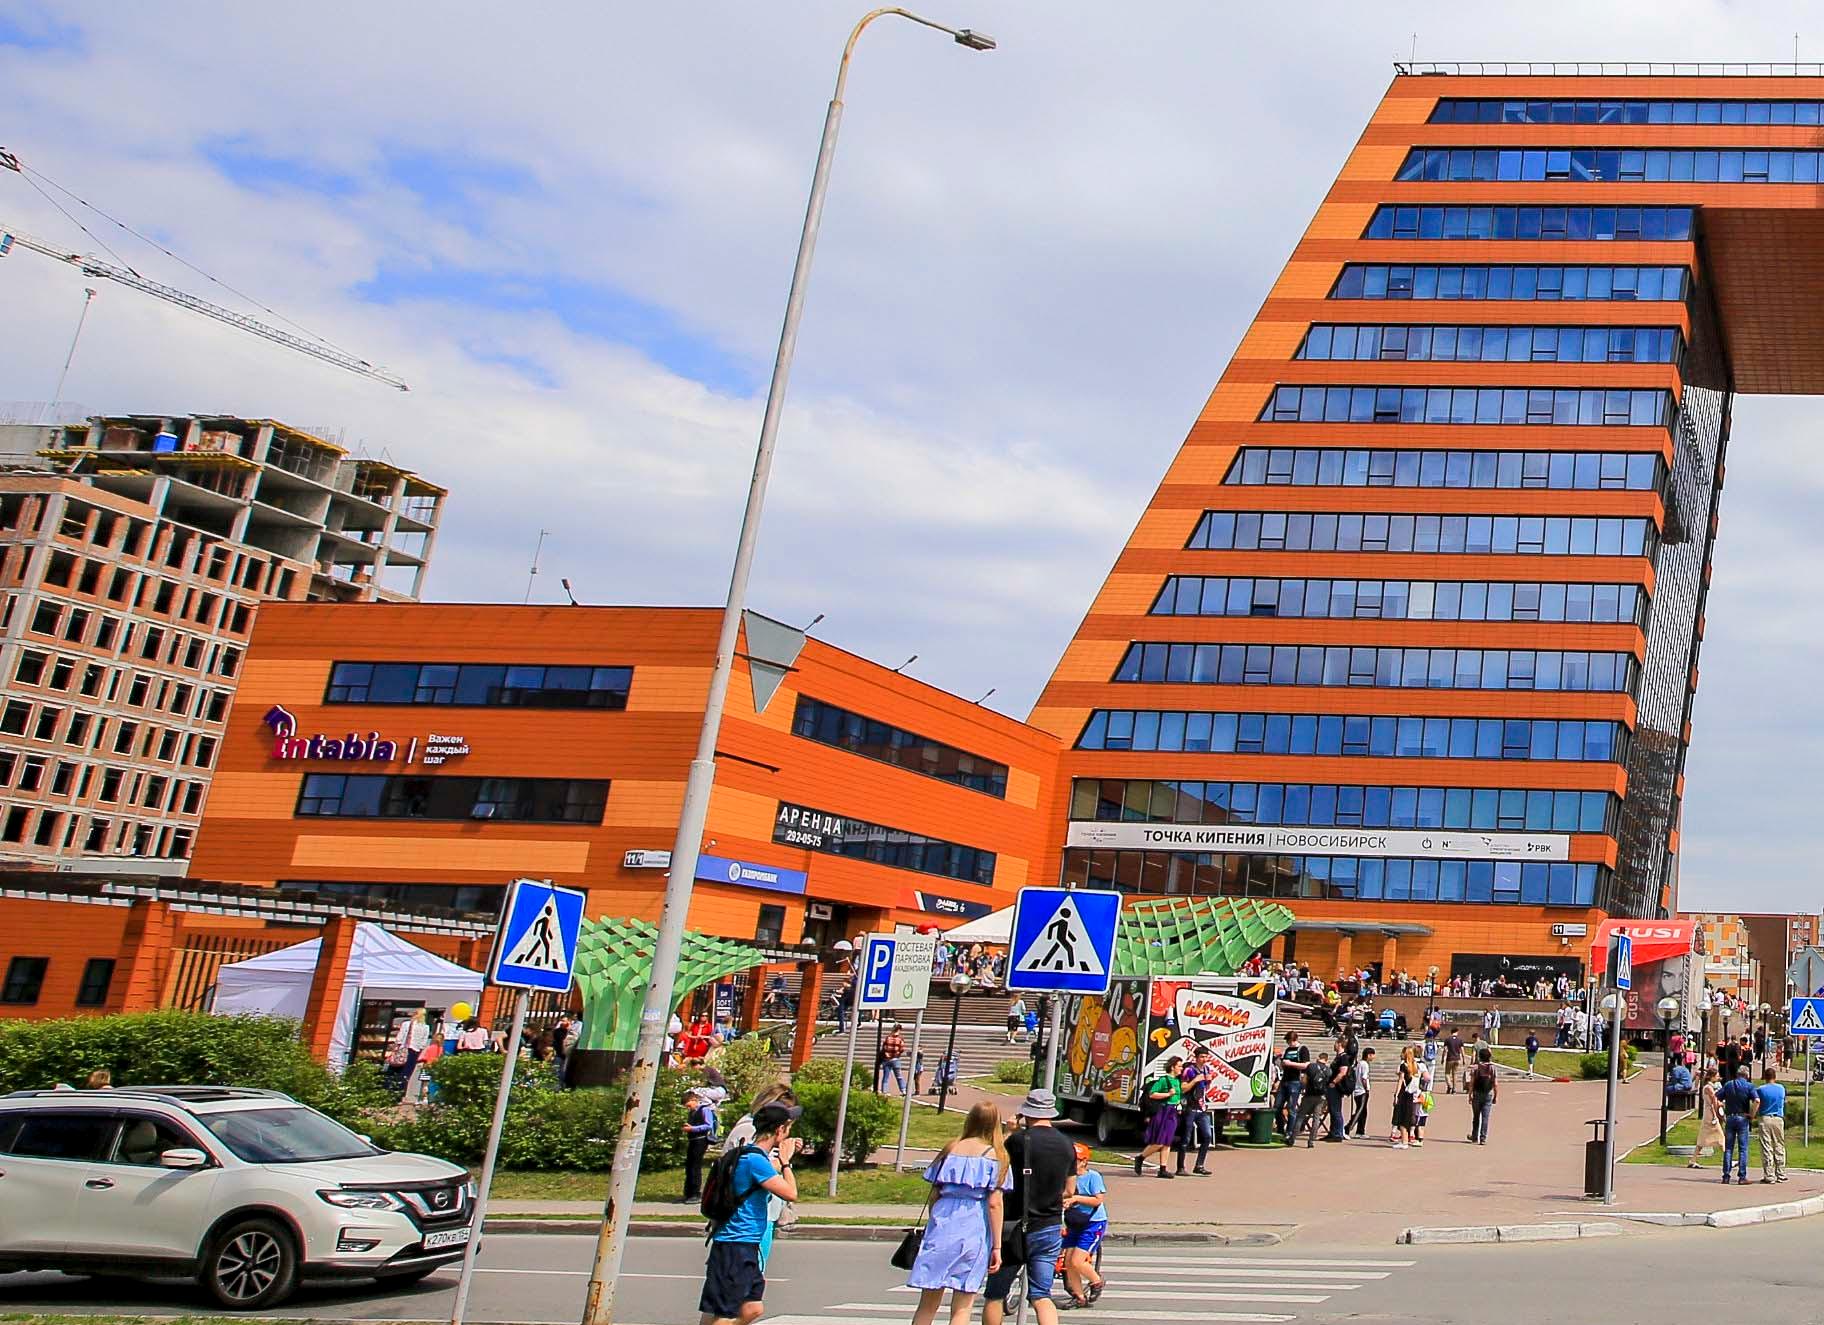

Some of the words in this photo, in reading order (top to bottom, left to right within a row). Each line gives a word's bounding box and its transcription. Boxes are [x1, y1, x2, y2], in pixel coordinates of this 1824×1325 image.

[272, 731, 397, 761] intabia
[428, 734, 464, 744] Важен
[425, 744, 470, 755] каждый
[423, 756, 446, 764] шаг
[779, 806, 842, 835] АРЕНДА
[786, 829, 822, 847] 292-05-75
[1143, 829, 1193, 843] ТОЧКА
[1196, 830, 1265, 845] КИПЕНИЯ
[1276, 834, 1387, 849] НОВОСИБИРСК
[1535, 845, 1552, 853] РВК
[626, 853, 643, 864] 11/1
[1554, 925, 1563, 934] 11
[896, 942, 933, 952] ГОСТЕВАЯ
[872, 944, 891, 980] P
[895, 954, 931, 963] ПАРКОВКА
[1184, 1000, 1250, 1028] ШАУРМА
[1628, 991, 1639, 1020] GUSI
[1209, 1036, 1229, 1048] MINI
[1235, 1029, 1266, 1043] СЫРНАЯ
[1225, 1042, 1266, 1060] КЛАССИКА
